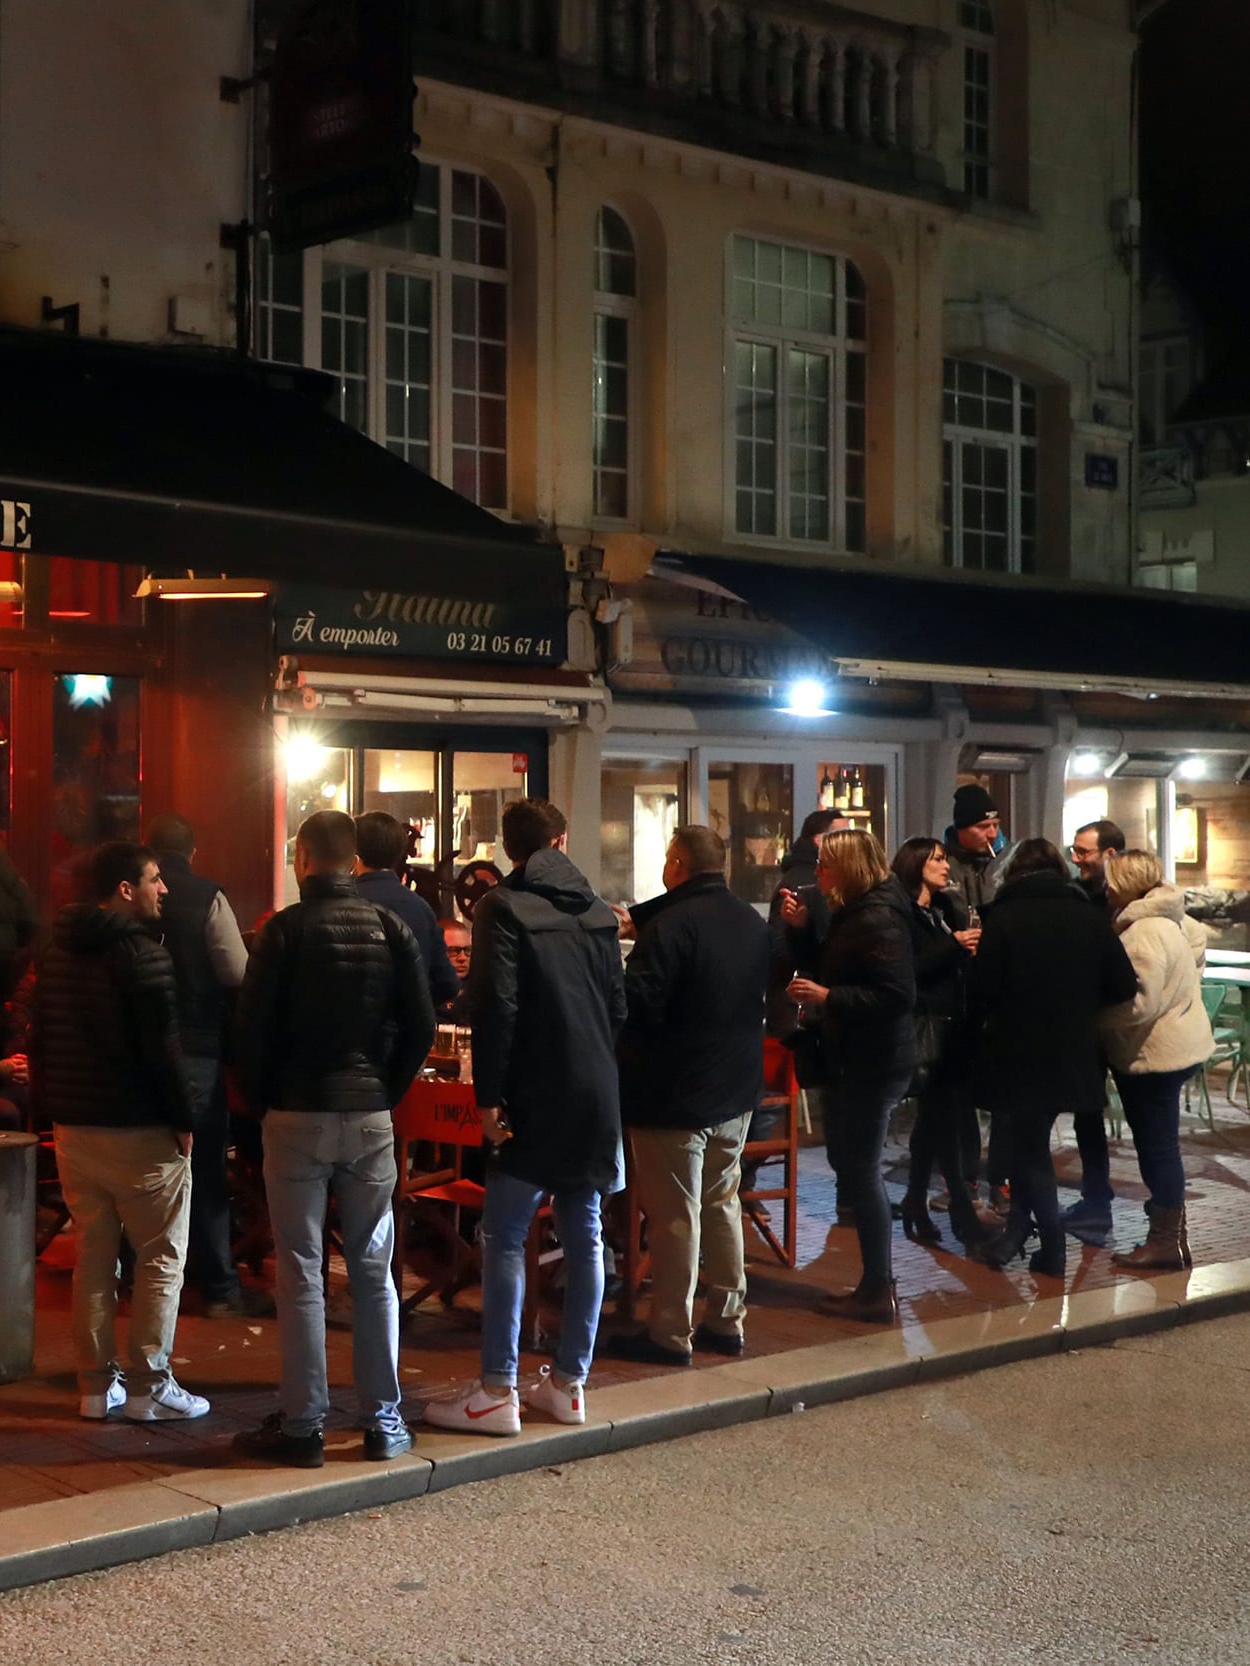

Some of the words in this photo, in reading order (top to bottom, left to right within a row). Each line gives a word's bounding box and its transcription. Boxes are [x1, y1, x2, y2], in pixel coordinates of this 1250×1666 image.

[320, 626, 399, 651] emporter
[447, 632, 466, 651] 03
[470, 633, 486, 652] 21
[491, 635, 511, 654] 05
[514, 636, 533, 656] 67
[535, 638, 552, 657] 41
